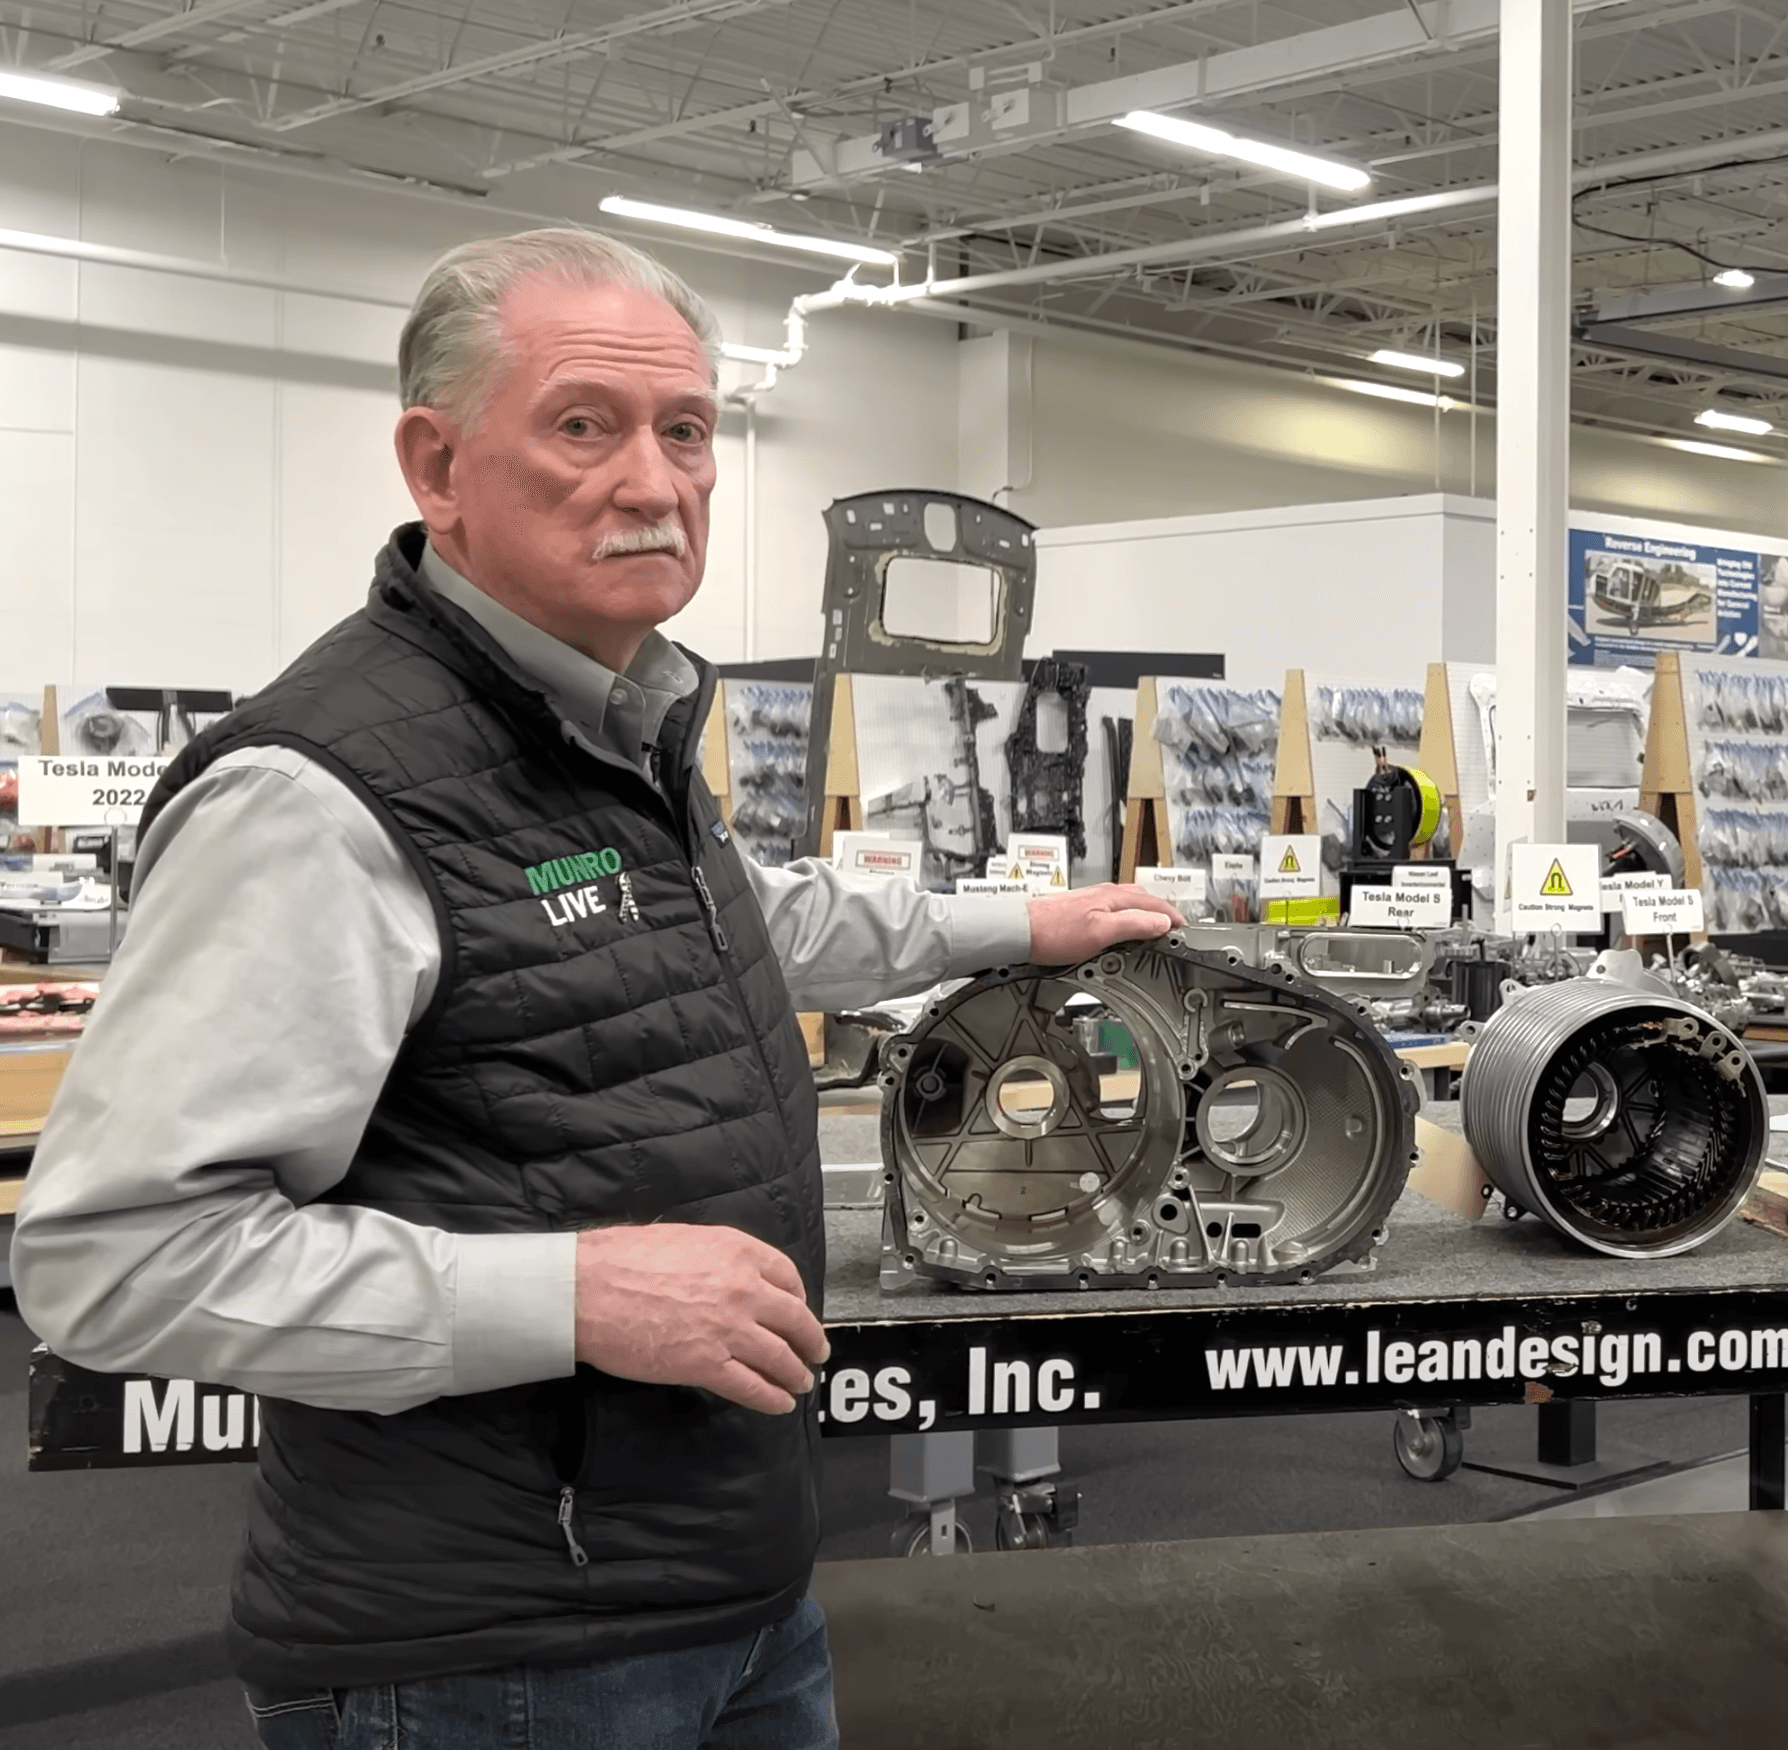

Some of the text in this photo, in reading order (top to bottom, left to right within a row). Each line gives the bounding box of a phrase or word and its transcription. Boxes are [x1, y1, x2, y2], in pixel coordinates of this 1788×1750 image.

[38, 760, 99, 777] Tesla
[92, 788, 146, 806] 2022
[525, 847, 622, 896] MUNRO
[1153, 874, 1176, 883] Chevy
[1600, 879, 1664, 890] esla Model Y
[963, 883, 1028, 895] Mustang Mach-E
[1362, 891, 1441, 904] Tesla Model S
[1633, 896, 1656, 907] Tesla
[1658, 895, 1685, 906] Model
[1687, 894, 1694, 906] S
[541, 885, 607, 927] LIVE
[1388, 906, 1415, 917] Rear
[1518, 903, 1594, 912] Caution Strong Magnets
[1653, 912, 1677, 922] Front
[1206, 1326, 1788, 1387] www.leandesign.com
[123, 1379, 260, 1453] Mu
[968, 1347, 1100, 1415] Inc.
